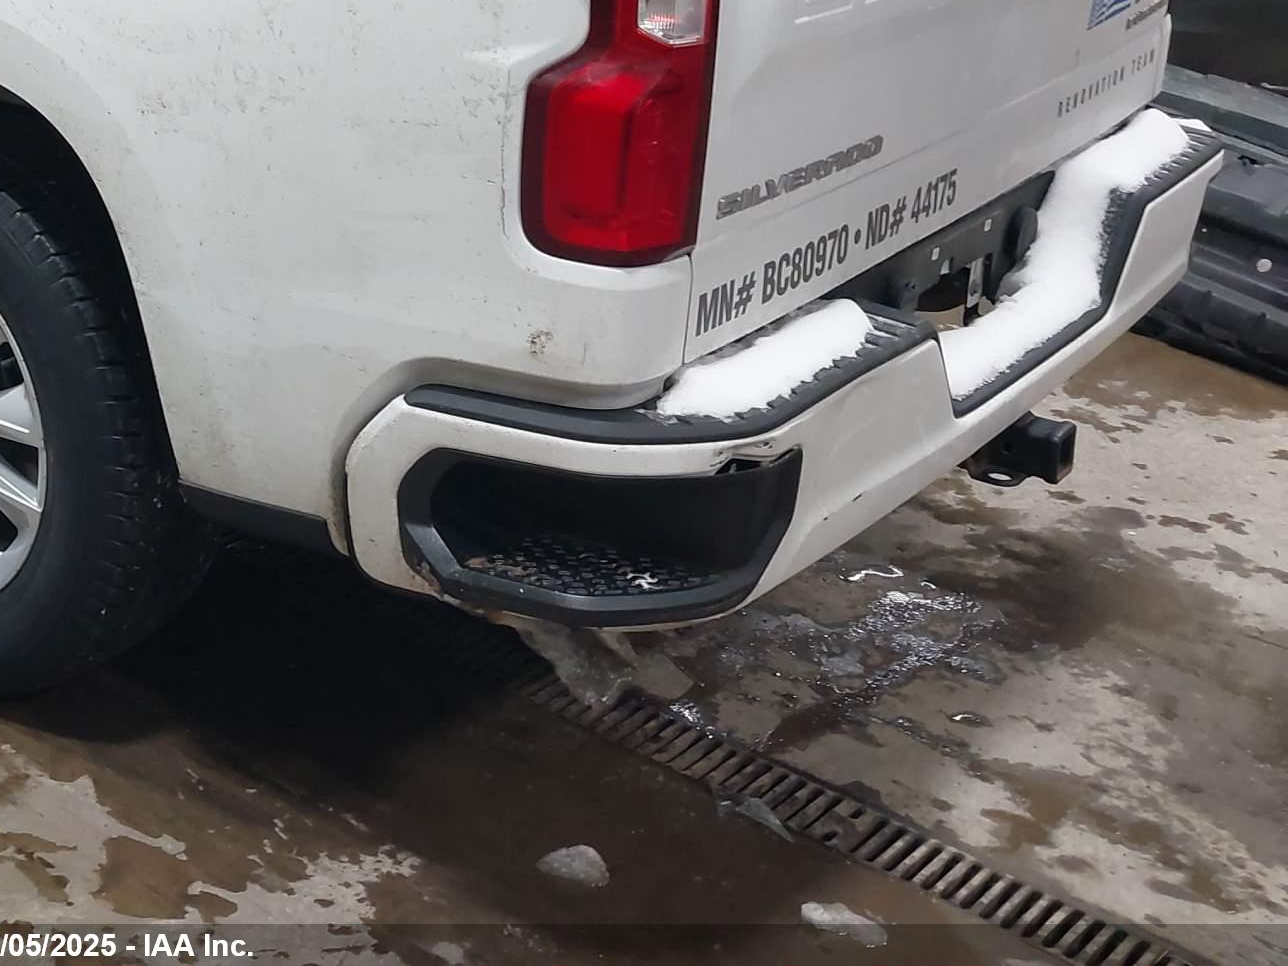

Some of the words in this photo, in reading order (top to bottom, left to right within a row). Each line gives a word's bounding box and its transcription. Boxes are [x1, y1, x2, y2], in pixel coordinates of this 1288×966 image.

[715, 134, 884, 221] SILVERADO
[695, 270, 757, 337] MN#
[761, 224, 849, 305] BC80970
[865, 196, 907, 251] ND#
[910, 168, 958, 224] 44175
